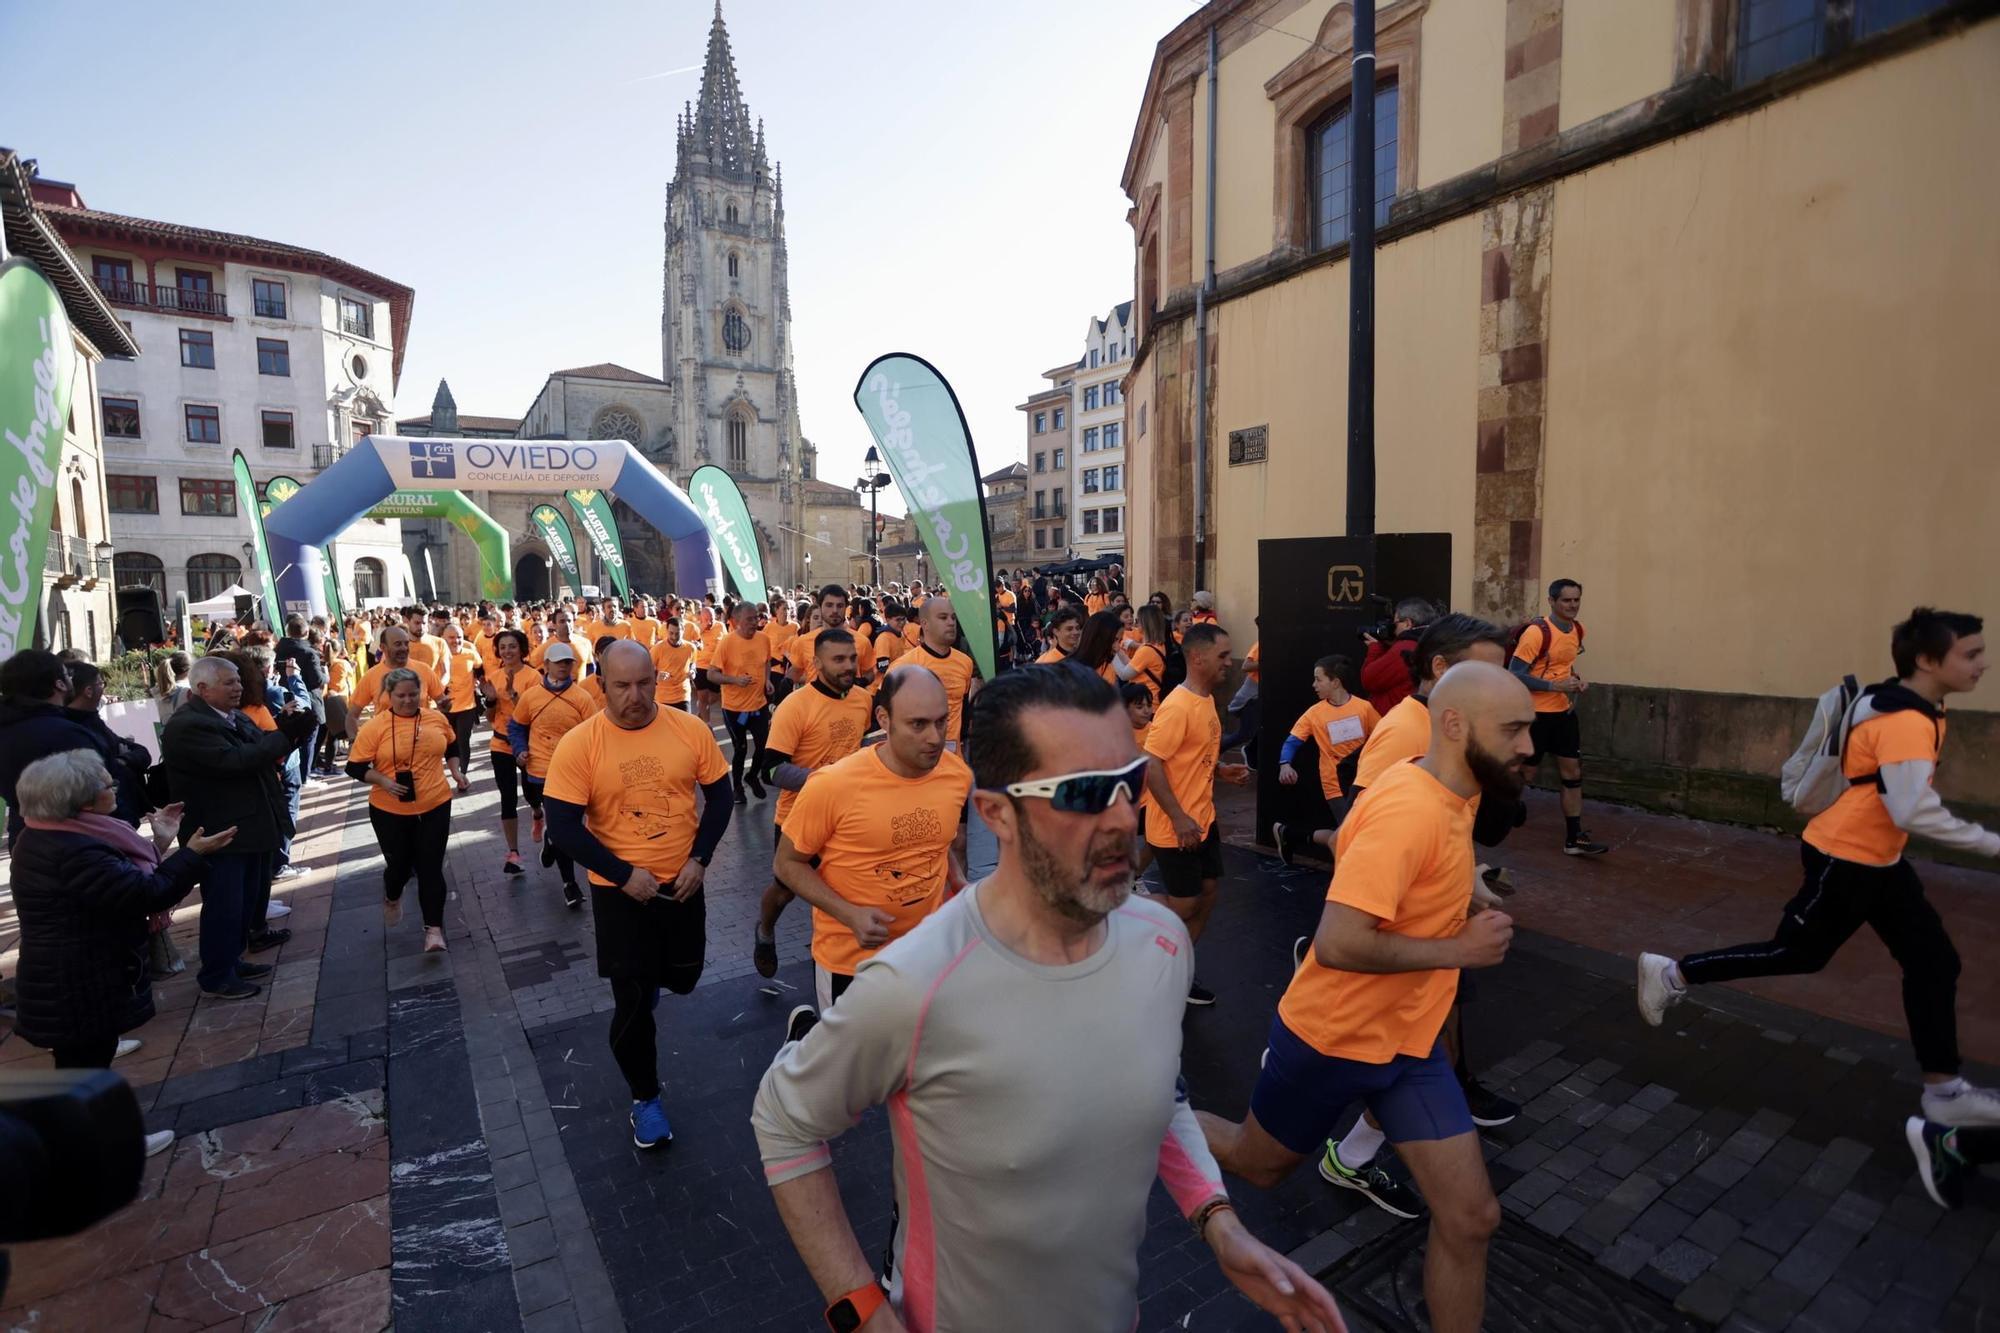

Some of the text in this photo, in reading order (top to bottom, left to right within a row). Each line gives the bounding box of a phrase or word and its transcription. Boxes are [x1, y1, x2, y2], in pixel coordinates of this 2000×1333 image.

[466, 444, 598, 471] OVIEDO
[537, 473, 551, 482] DE
[553, 473, 600, 483] DEPORTES
[383, 494, 438, 506] RURAL
[371, 506, 425, 514] ASTURIAS
